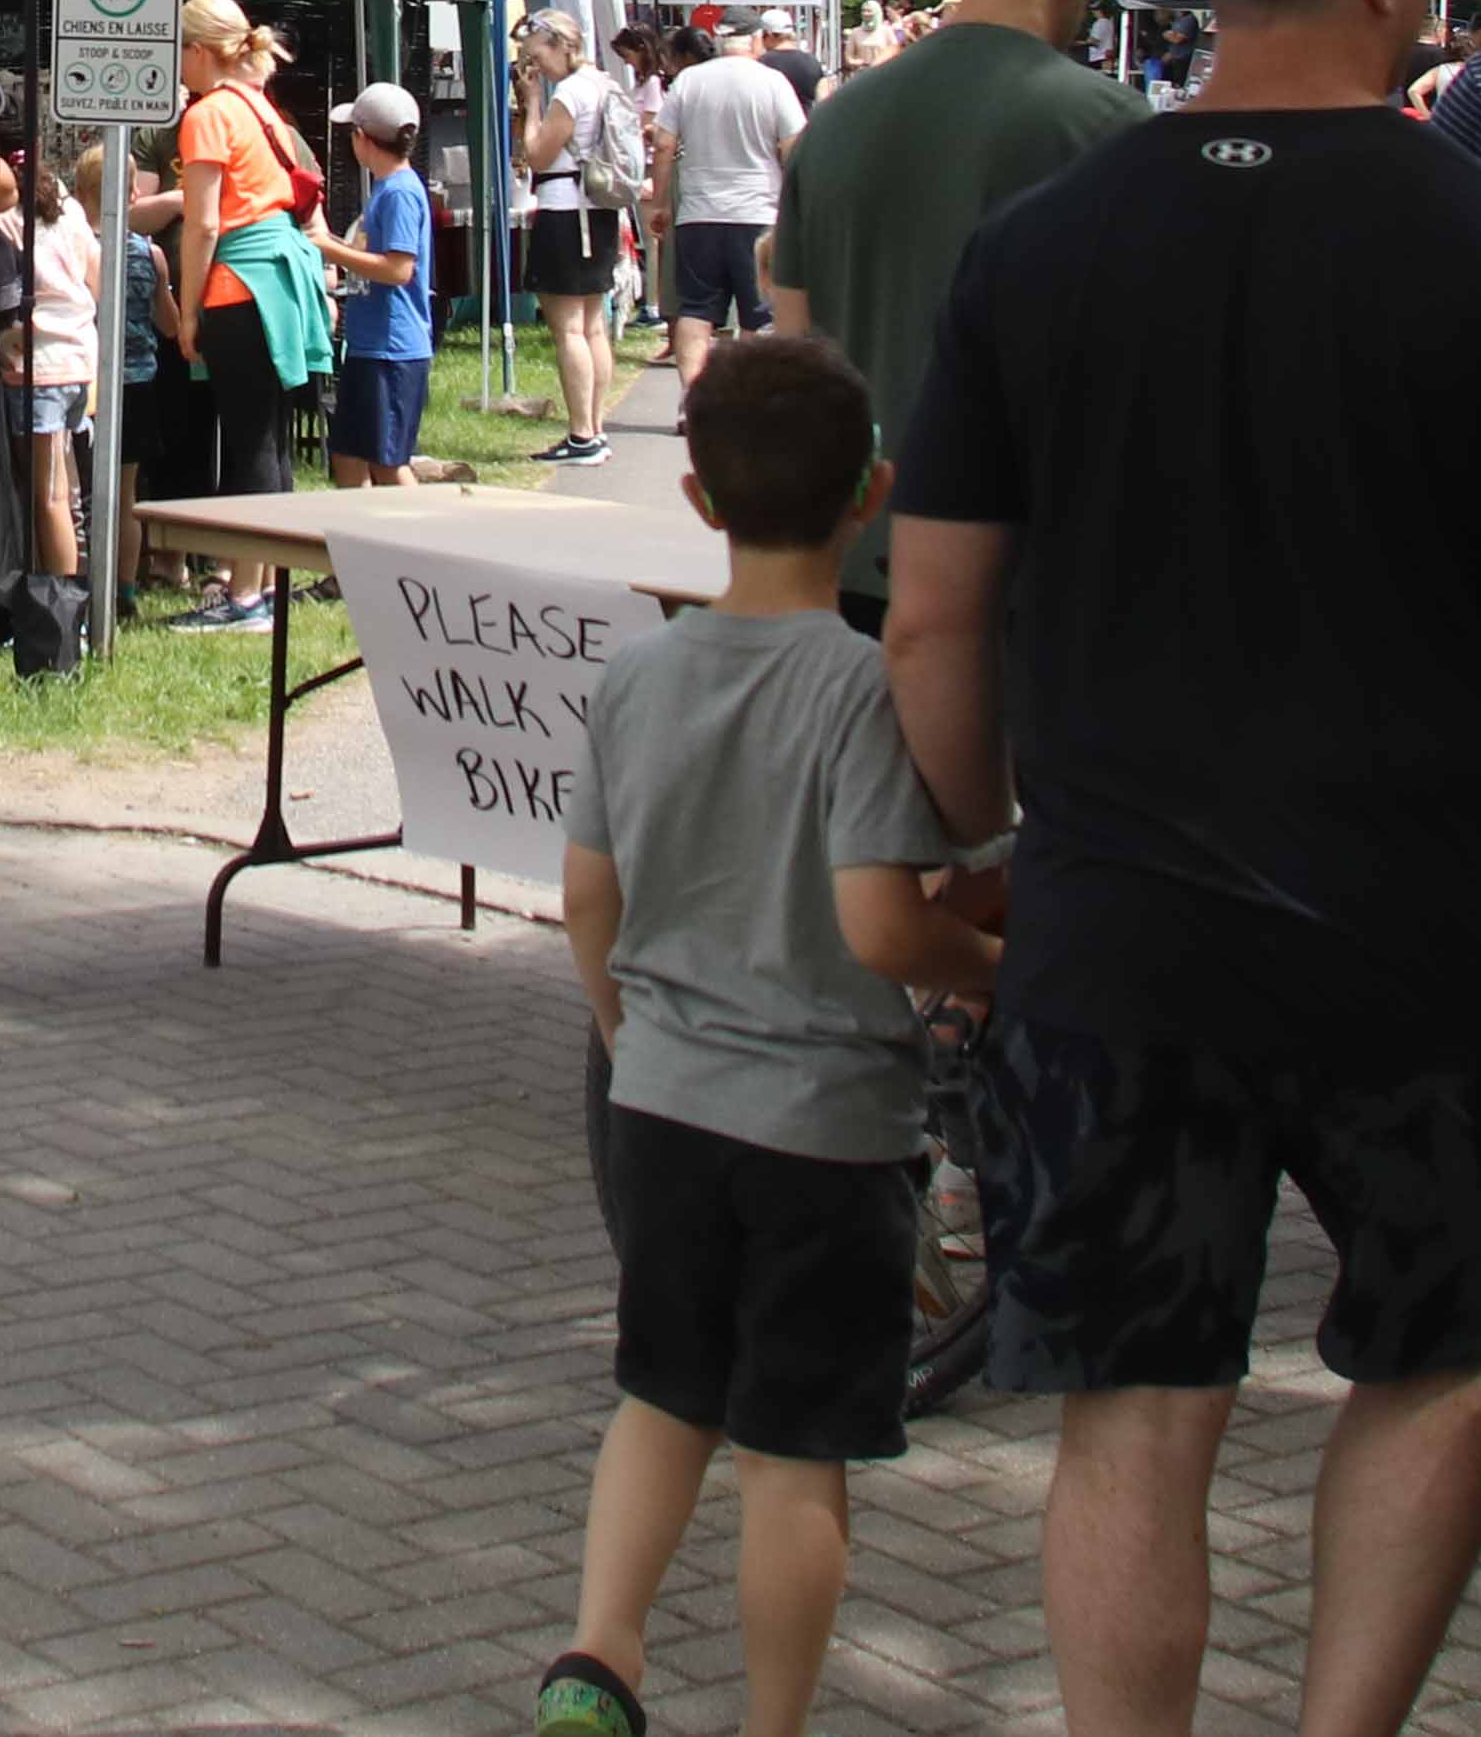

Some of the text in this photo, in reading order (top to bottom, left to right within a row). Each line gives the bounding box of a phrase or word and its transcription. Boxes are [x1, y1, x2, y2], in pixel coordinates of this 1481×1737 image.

[62, 20, 169, 36] CHIENS EN LAISSE
[78, 47, 109, 59] STOOP
[122, 48, 154, 60] SCOOP
[146, 100, 169, 111] MAIN
[398, 577, 611, 663] PLEASE
[401, 669, 551, 738] WALK
